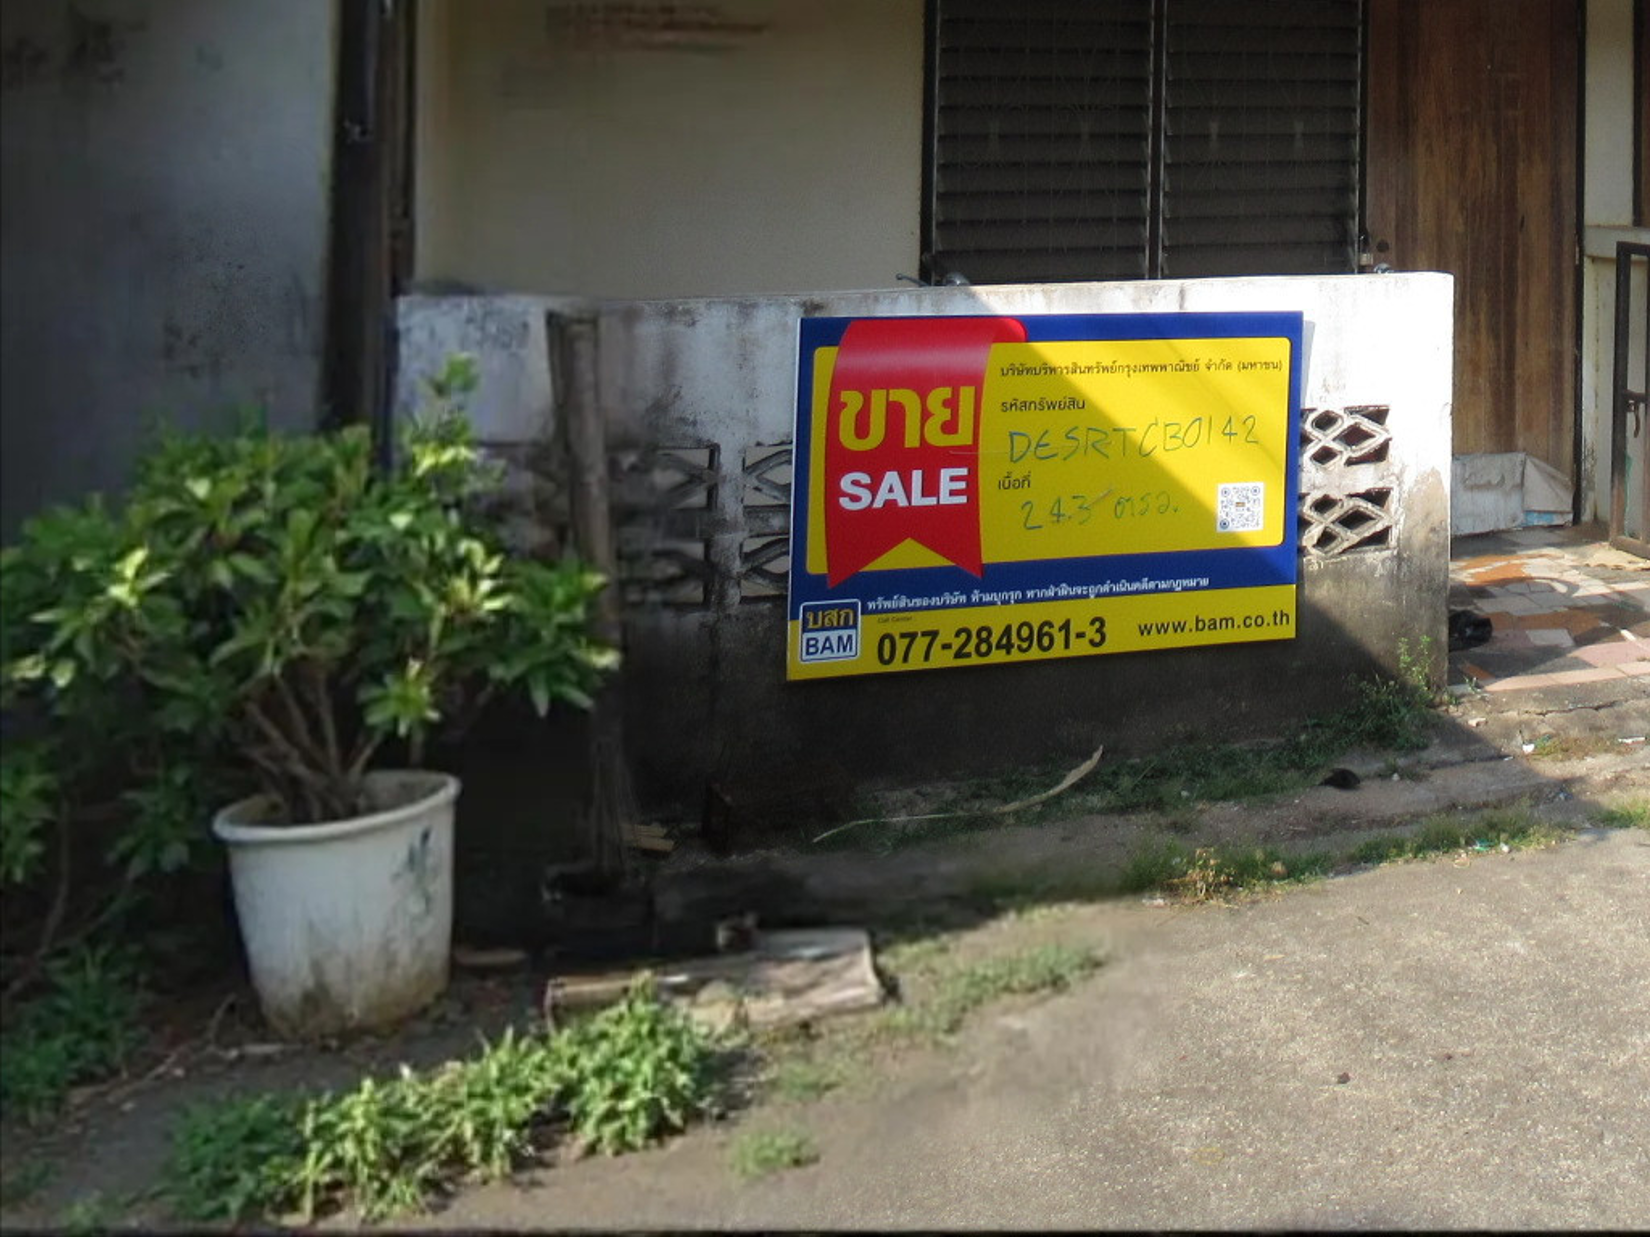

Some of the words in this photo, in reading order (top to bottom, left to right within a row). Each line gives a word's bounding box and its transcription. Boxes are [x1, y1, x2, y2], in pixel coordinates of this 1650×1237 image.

[1205, 360, 1232, 371] จำกัด
[1238, 360, 1282, 372] (มหาชน)
[1001, 396, 1086, 413] รหัสทรัพย์สิน
[839, 386, 976, 451] ขาย
[839, 467, 969, 510] SALE
[998, 471, 1031, 490] เนื้อที่
[867, 592, 967, 611] ทรัพย์สินของบริษัท
[971, 589, 1022, 606] ห้ามบุกรุก
[806, 609, 854, 629] บสก
[805, 634, 853, 656] BAM
[877, 616, 1107, 665] 077-284961-3
[1138, 610, 1290, 637] www.bam.co.th
